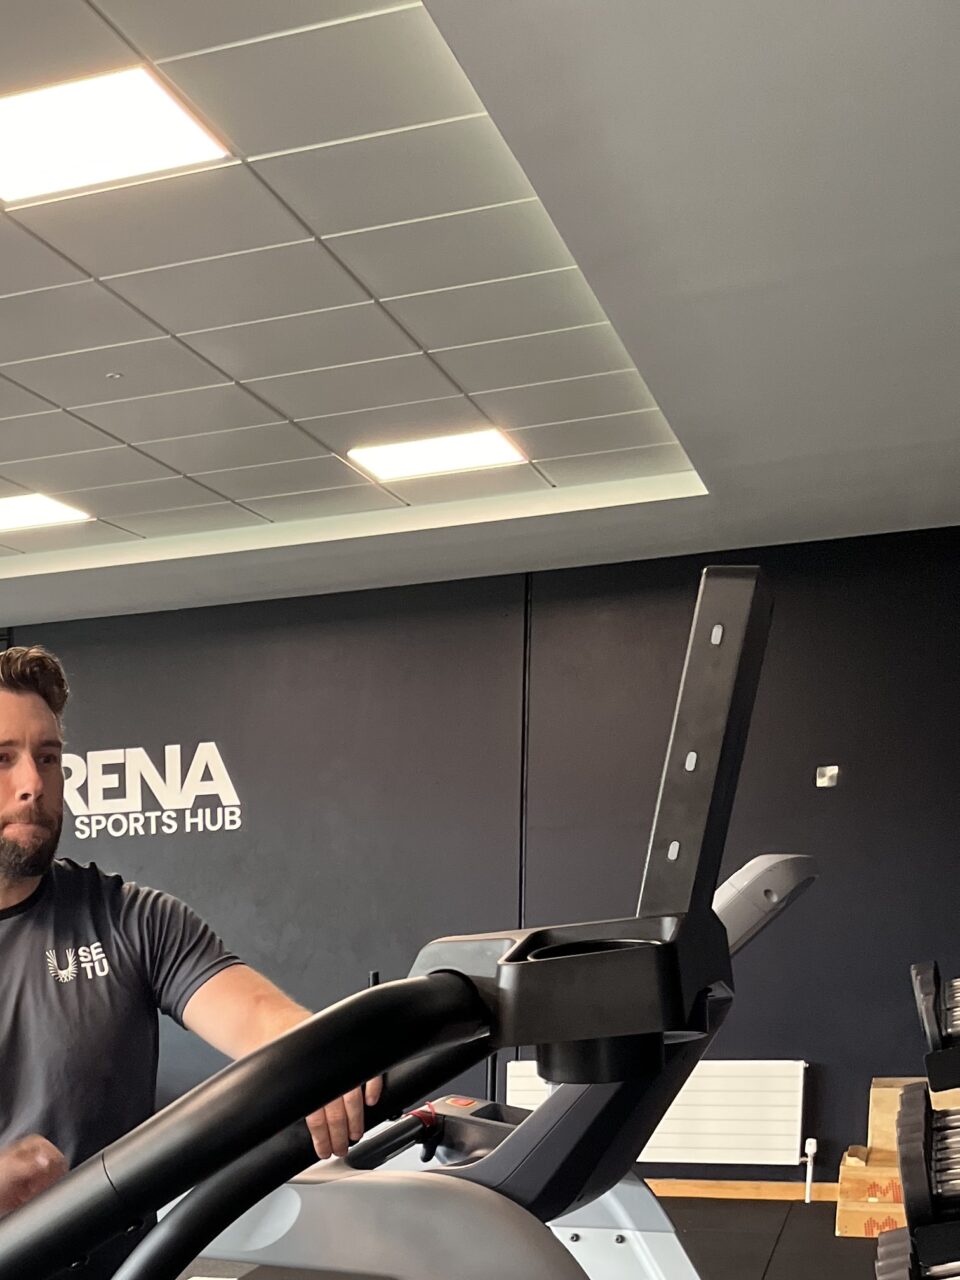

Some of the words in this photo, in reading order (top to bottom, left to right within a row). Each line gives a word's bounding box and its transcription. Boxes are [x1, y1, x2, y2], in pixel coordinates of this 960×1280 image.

[61, 741, 241, 816] RENA
[74, 810, 178, 840] SPORTS
[184, 806, 242, 833] HUB
[77, 941, 106, 962] SE
[80, 958, 109, 979] TU
